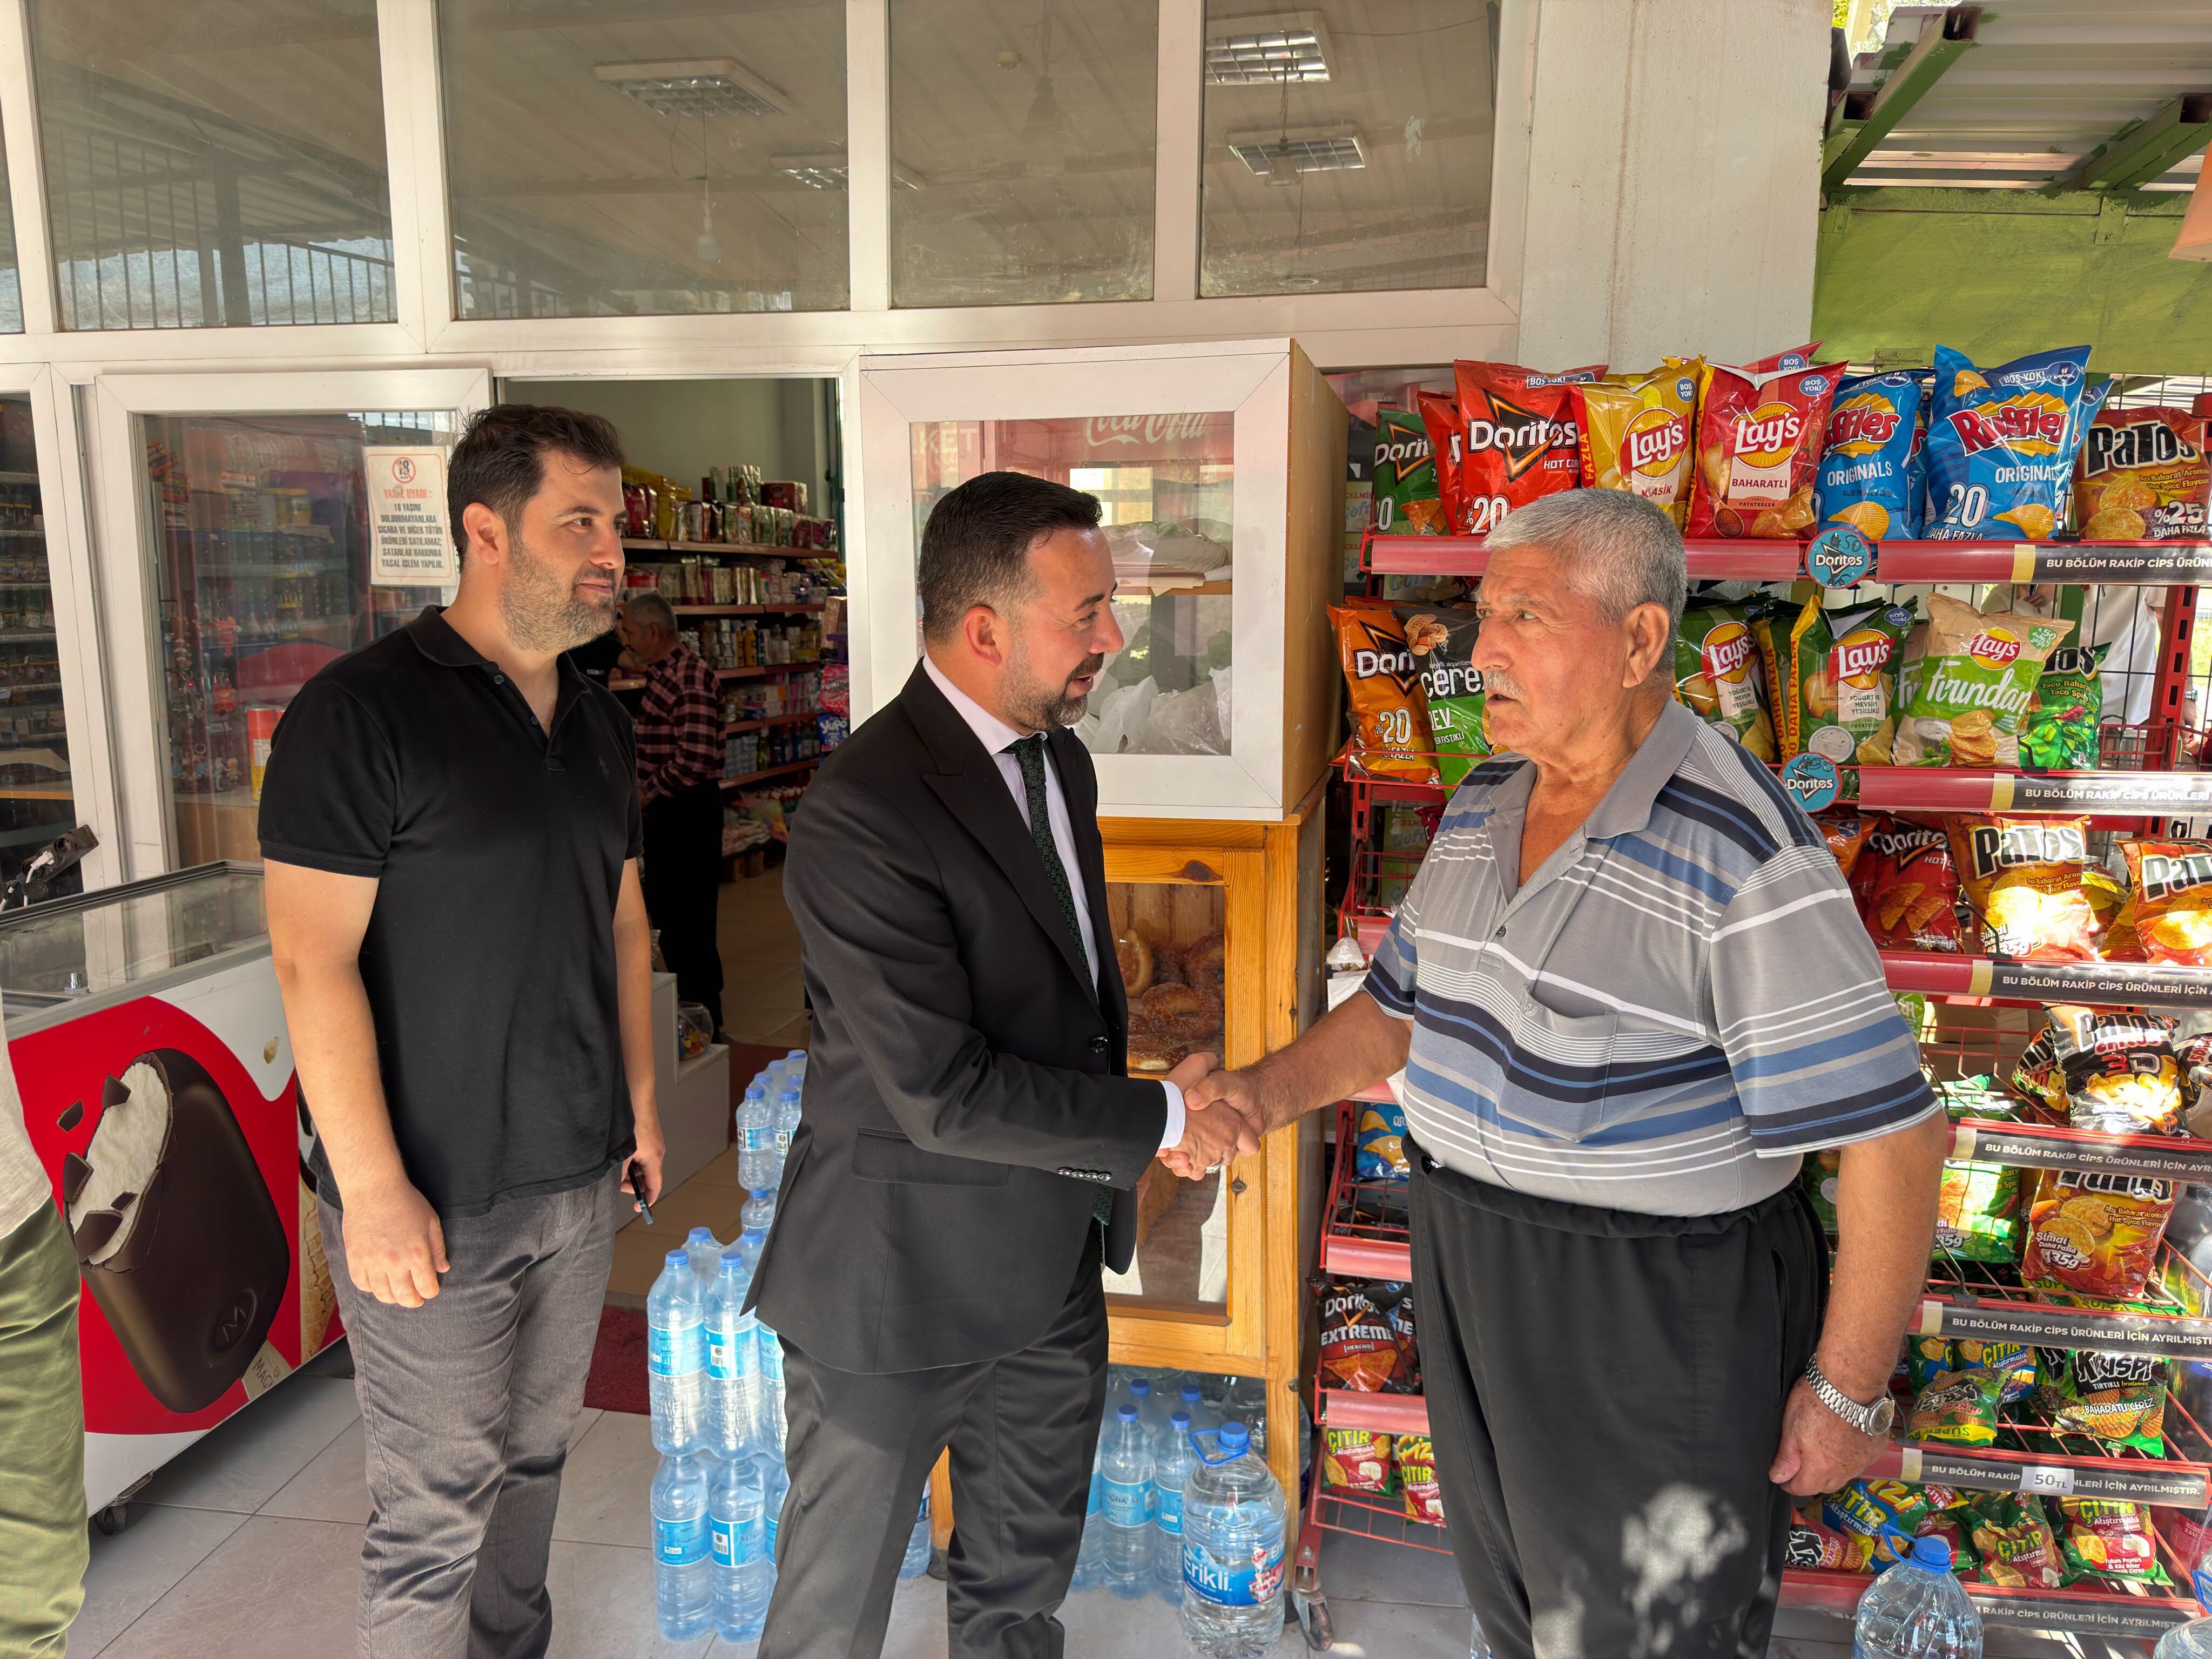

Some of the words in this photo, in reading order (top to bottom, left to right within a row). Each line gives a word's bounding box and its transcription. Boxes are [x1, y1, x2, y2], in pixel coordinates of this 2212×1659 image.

[1530, 376, 1545, 386] BOŞ
[2004, 375, 2021, 385] BOŞ
[2024, 370, 2045, 381] YOK!
[1471, 420, 1577, 451] Doritos
[1735, 412, 1800, 453] Lay's
[1631, 420, 1684, 468] Lay's
[1544, 459, 1564, 469] HOT
[1580, 433, 1591, 480] FAZLA
[399, 460, 410, 476] 18
[1827, 461, 1893, 487] ORIGINALS
[1732, 479, 1788, 488] BAHARATLI
[2152, 472, 2182, 482] Baharat
[383, 489, 404, 498] YASAL
[407, 489, 427, 498] UYARI
[2161, 483, 2181, 491] Spice
[394, 503, 401, 511] 18
[402, 503, 421, 512] YAŞINI
[2154, 501, 2204, 524] %25
[381, 515, 437, 523] DOLDURMAYANLARA
[378, 525, 398, 534] SİGARA
[425, 525, 443, 535] TÜTÜN
[2154, 524, 2180, 538] DAHA
[2182, 524, 2206, 534] FAZLA
[381, 536, 407, 545] ÜRÜNLERİ
[383, 548, 412, 556] SATANLAR
[414, 549, 442, 557] HAKKINDA
[1816, 554, 1863, 566] Doritos
[382, 558, 401, 567] YASAL
[402, 558, 420, 569] İŞLEM
[2046, 559, 2062, 568] BU
[2066, 557, 2106, 568] BÖLÜM
[2109, 557, 2144, 568] RAKİP
[2147, 557, 2174, 568] CİPS
[1972, 635, 2019, 660] Lay's
[1790, 639, 1798, 688] FAZLA
[1838, 639, 1889, 678] Lay's
[1766, 649, 1778, 694] FAZLA
[1421, 666, 1484, 703] çere
[1735, 693, 1751, 702] MEVSİM
[2072, 690, 2089, 702] Spicy
[1788, 693, 1798, 736] DAHA
[1375, 709, 1411, 744] %20
[1787, 778, 1833, 790] Doritos
[2026, 789, 2041, 797] BU
[2044, 788, 2083, 799] BÖLÜM
[1880, 830, 1948, 855] Dorito
[2036, 876, 2062, 885] Baharat
[2003, 976, 2019, 984] BU
[2021, 976, 2059, 987] BÖLÜM
[2062, 980, 2095, 989] RAKİP
[2098, 980, 2123, 991] CİPS
[2126, 982, 2182, 994] ÜRÜNLERİ
[2184, 984, 2207, 995] İÇİN
[1985, 1143, 2000, 1152] BU
[2002, 1144, 2041, 1157] BÖLÜM
[2043, 1149, 2076, 1161] RAKİP
[2079, 1152, 2103, 1163] CİPS
[2106, 1155, 2161, 1169] ÜRÜNLERİ
[2163, 1160, 2187, 1171] İÇİN
[2123, 1217, 2140, 1226] Spice
[2036, 1231, 2069, 1245] Şimdi
[2039, 1241, 2057, 1250] Daha
[2056, 1244, 2078, 1254] Fazla
[2045, 1251, 2082, 1271] 135g
[1321, 1324, 1394, 1346] EXTREME
[1953, 1318, 1967, 1326] BU
[1970, 1319, 2007, 1331] BÖLÜM
[2009, 1323, 2042, 1333] RAKİP
[2044, 1326, 2068, 1336] CİPS
[2071, 1327, 2125, 1340] ÜRÜNLERİ
[2127, 1330, 2149, 1343] İÇİN
[2093, 1381, 2120, 1391] TIRTIKLI
[2085, 1402, 2128, 1415] BAHARATLI
[2130, 1398, 2155, 1413] ÇEREZ
[1328, 1431, 1371, 1453] ÇITIR
[1932, 1466, 1948, 1474] BU
[1952, 1466, 1986, 1478] BÖLÜM
[1988, 1472, 2020, 1482] RAKİP
[2105, 1479, 2127, 1492] İÇİN
[2129, 1482, 2201, 1496] AYRILMIŞTIR.
[2095, 1516, 2140, 1526] Atıştırmalık
[1997, 1530, 2043, 1564] ÇITIR
[1184, 1550, 1229, 1591] Erikli
[1983, 1607, 2015, 1616] RAKİP
[2017, 1609, 2040, 1619] CİPS
[2043, 1611, 2095, 1622] ÜRÜNLERİ
[2098, 1613, 2119, 1624] İÇİN
